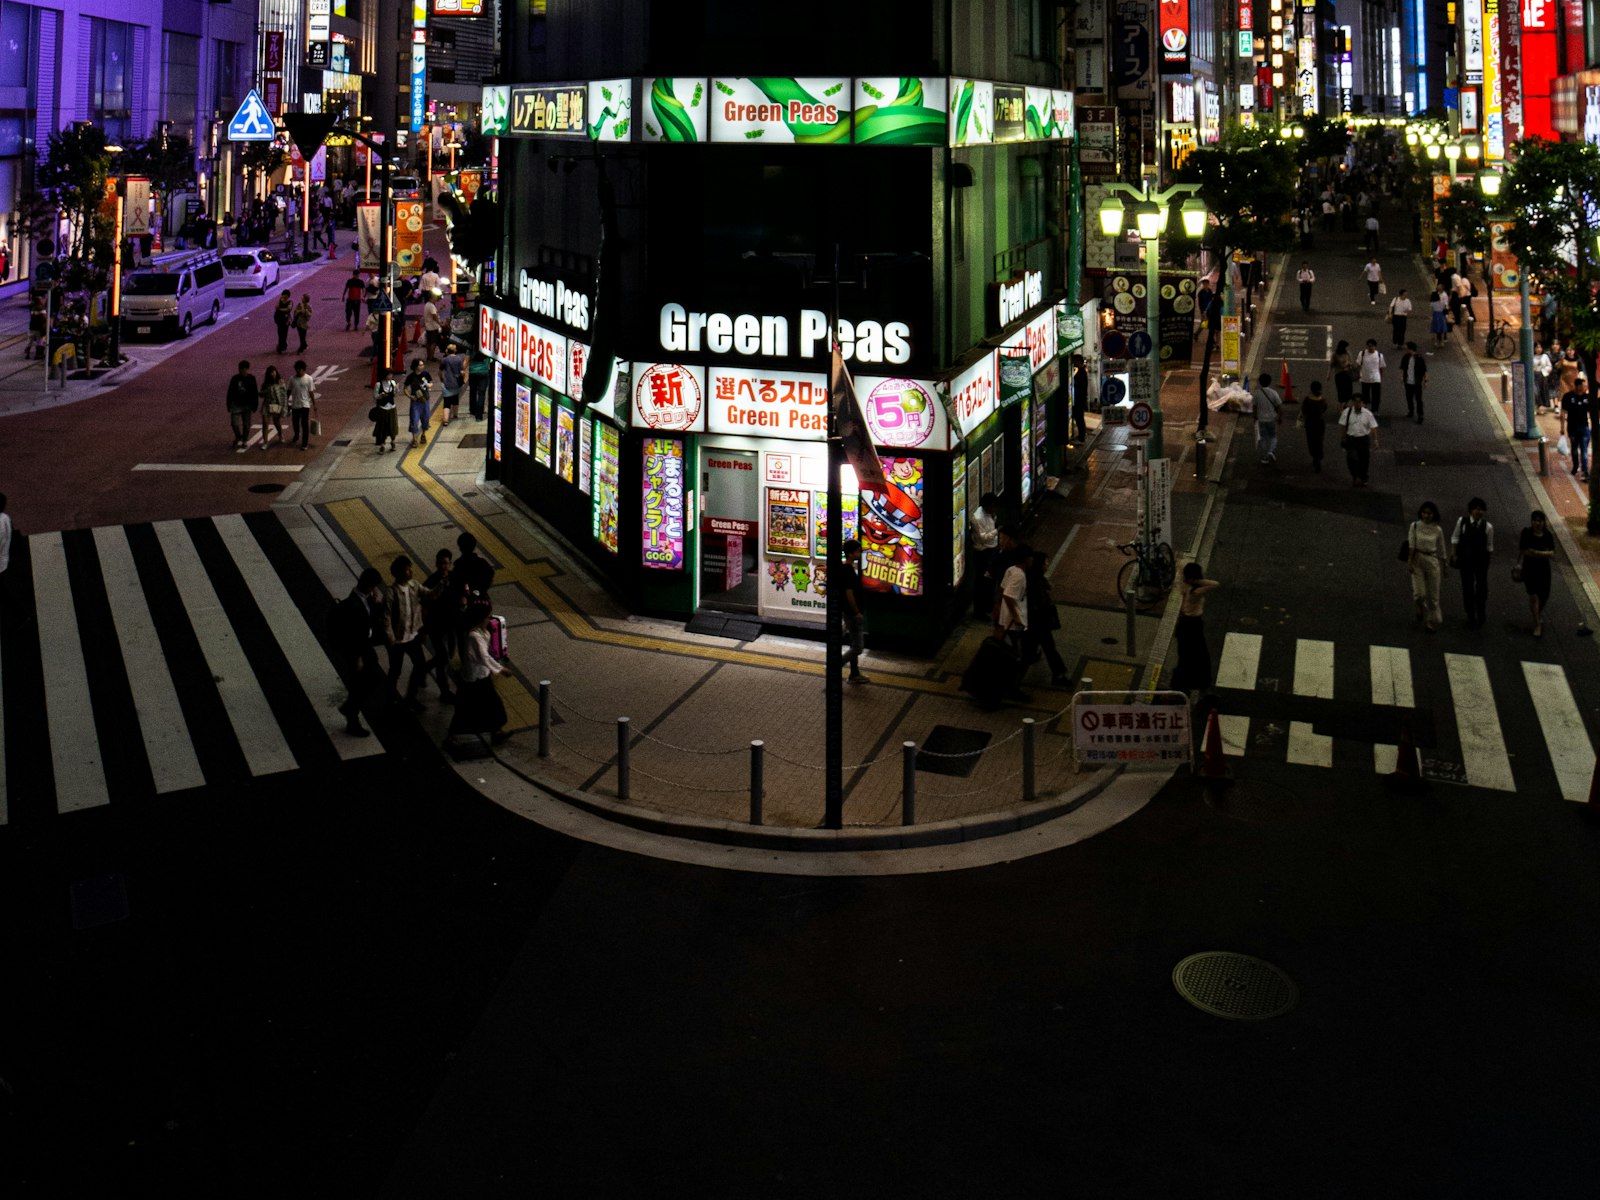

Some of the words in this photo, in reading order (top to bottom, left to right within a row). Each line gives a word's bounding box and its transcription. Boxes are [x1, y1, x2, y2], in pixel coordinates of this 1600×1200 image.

[268, 34, 279, 69] マルハン
[1122, 24, 1142, 77] アース
[513, 90, 584, 130] レア台の聖地
[725, 101, 781, 122] Green
[789, 101, 838, 124] Peas
[519, 268, 555, 317] Green
[556, 279, 589, 331] Peas
[999, 280, 1024, 328] Green
[1024, 270, 1042, 311] Peas
[480, 306, 516, 363] Green
[521, 323, 553, 381] Peas
[660, 302, 788, 356] Green
[800, 309, 910, 364] Peas
[649, 370, 684, 409] 新
[715, 376, 827, 405] 選べるスロッ
[649, 410, 697, 425] スロット
[727, 404, 779, 427] Green
[873, 392, 922, 430] 5円
[654, 439, 673, 455] 1F
[708, 458, 733, 469] Green
[733, 460, 753, 471] Peas
[645, 456, 664, 547] ジャグラー
[665, 457, 682, 538] まるごと
[711, 519, 731, 529] Green
[732, 521, 749, 531] Peas
[645, 551, 673, 562] GOGO
[863, 562, 920, 591] JUGGLER
[791, 597, 812, 607] Green
[813, 600, 827, 608] Pea
[1102, 712, 1184, 729] 車両通行止
